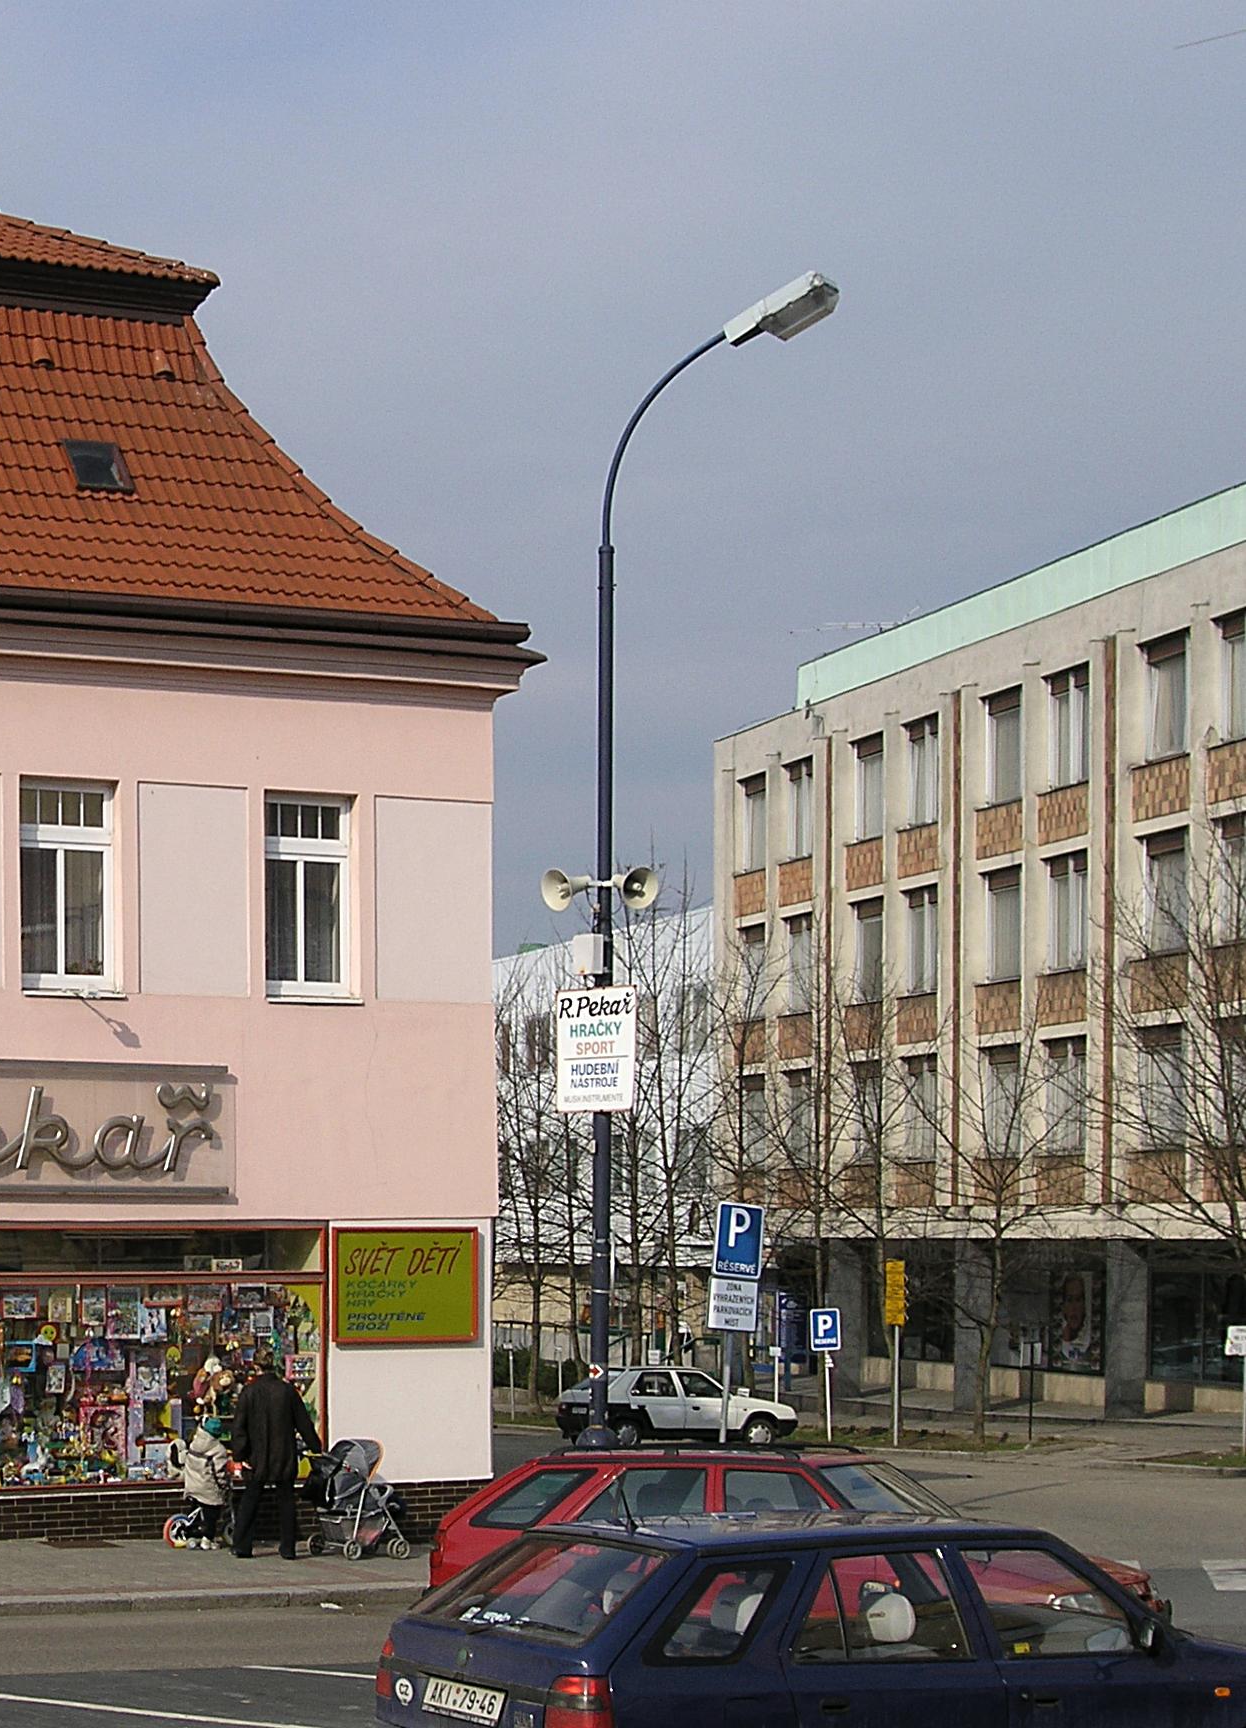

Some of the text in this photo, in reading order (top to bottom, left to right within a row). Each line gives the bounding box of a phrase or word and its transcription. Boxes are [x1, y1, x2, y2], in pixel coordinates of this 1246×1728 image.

[570, 1019, 622, 1038] HRAČKY
[576, 1040, 616, 1056] SPORT
[570, 1059, 620, 1076] HUDEBNÍ
[570, 1076, 619, 1089] NÁSTROJE
[727, 1207, 751, 1248] P
[344, 1240, 463, 1277] SVĚT DĚTÍ
[346, 1300, 376, 1308] HRY
[817, 1314, 833, 1338] P
[398, 1682, 410, 1697] CZ
[429, 1682, 497, 1715] AKI 79-46
